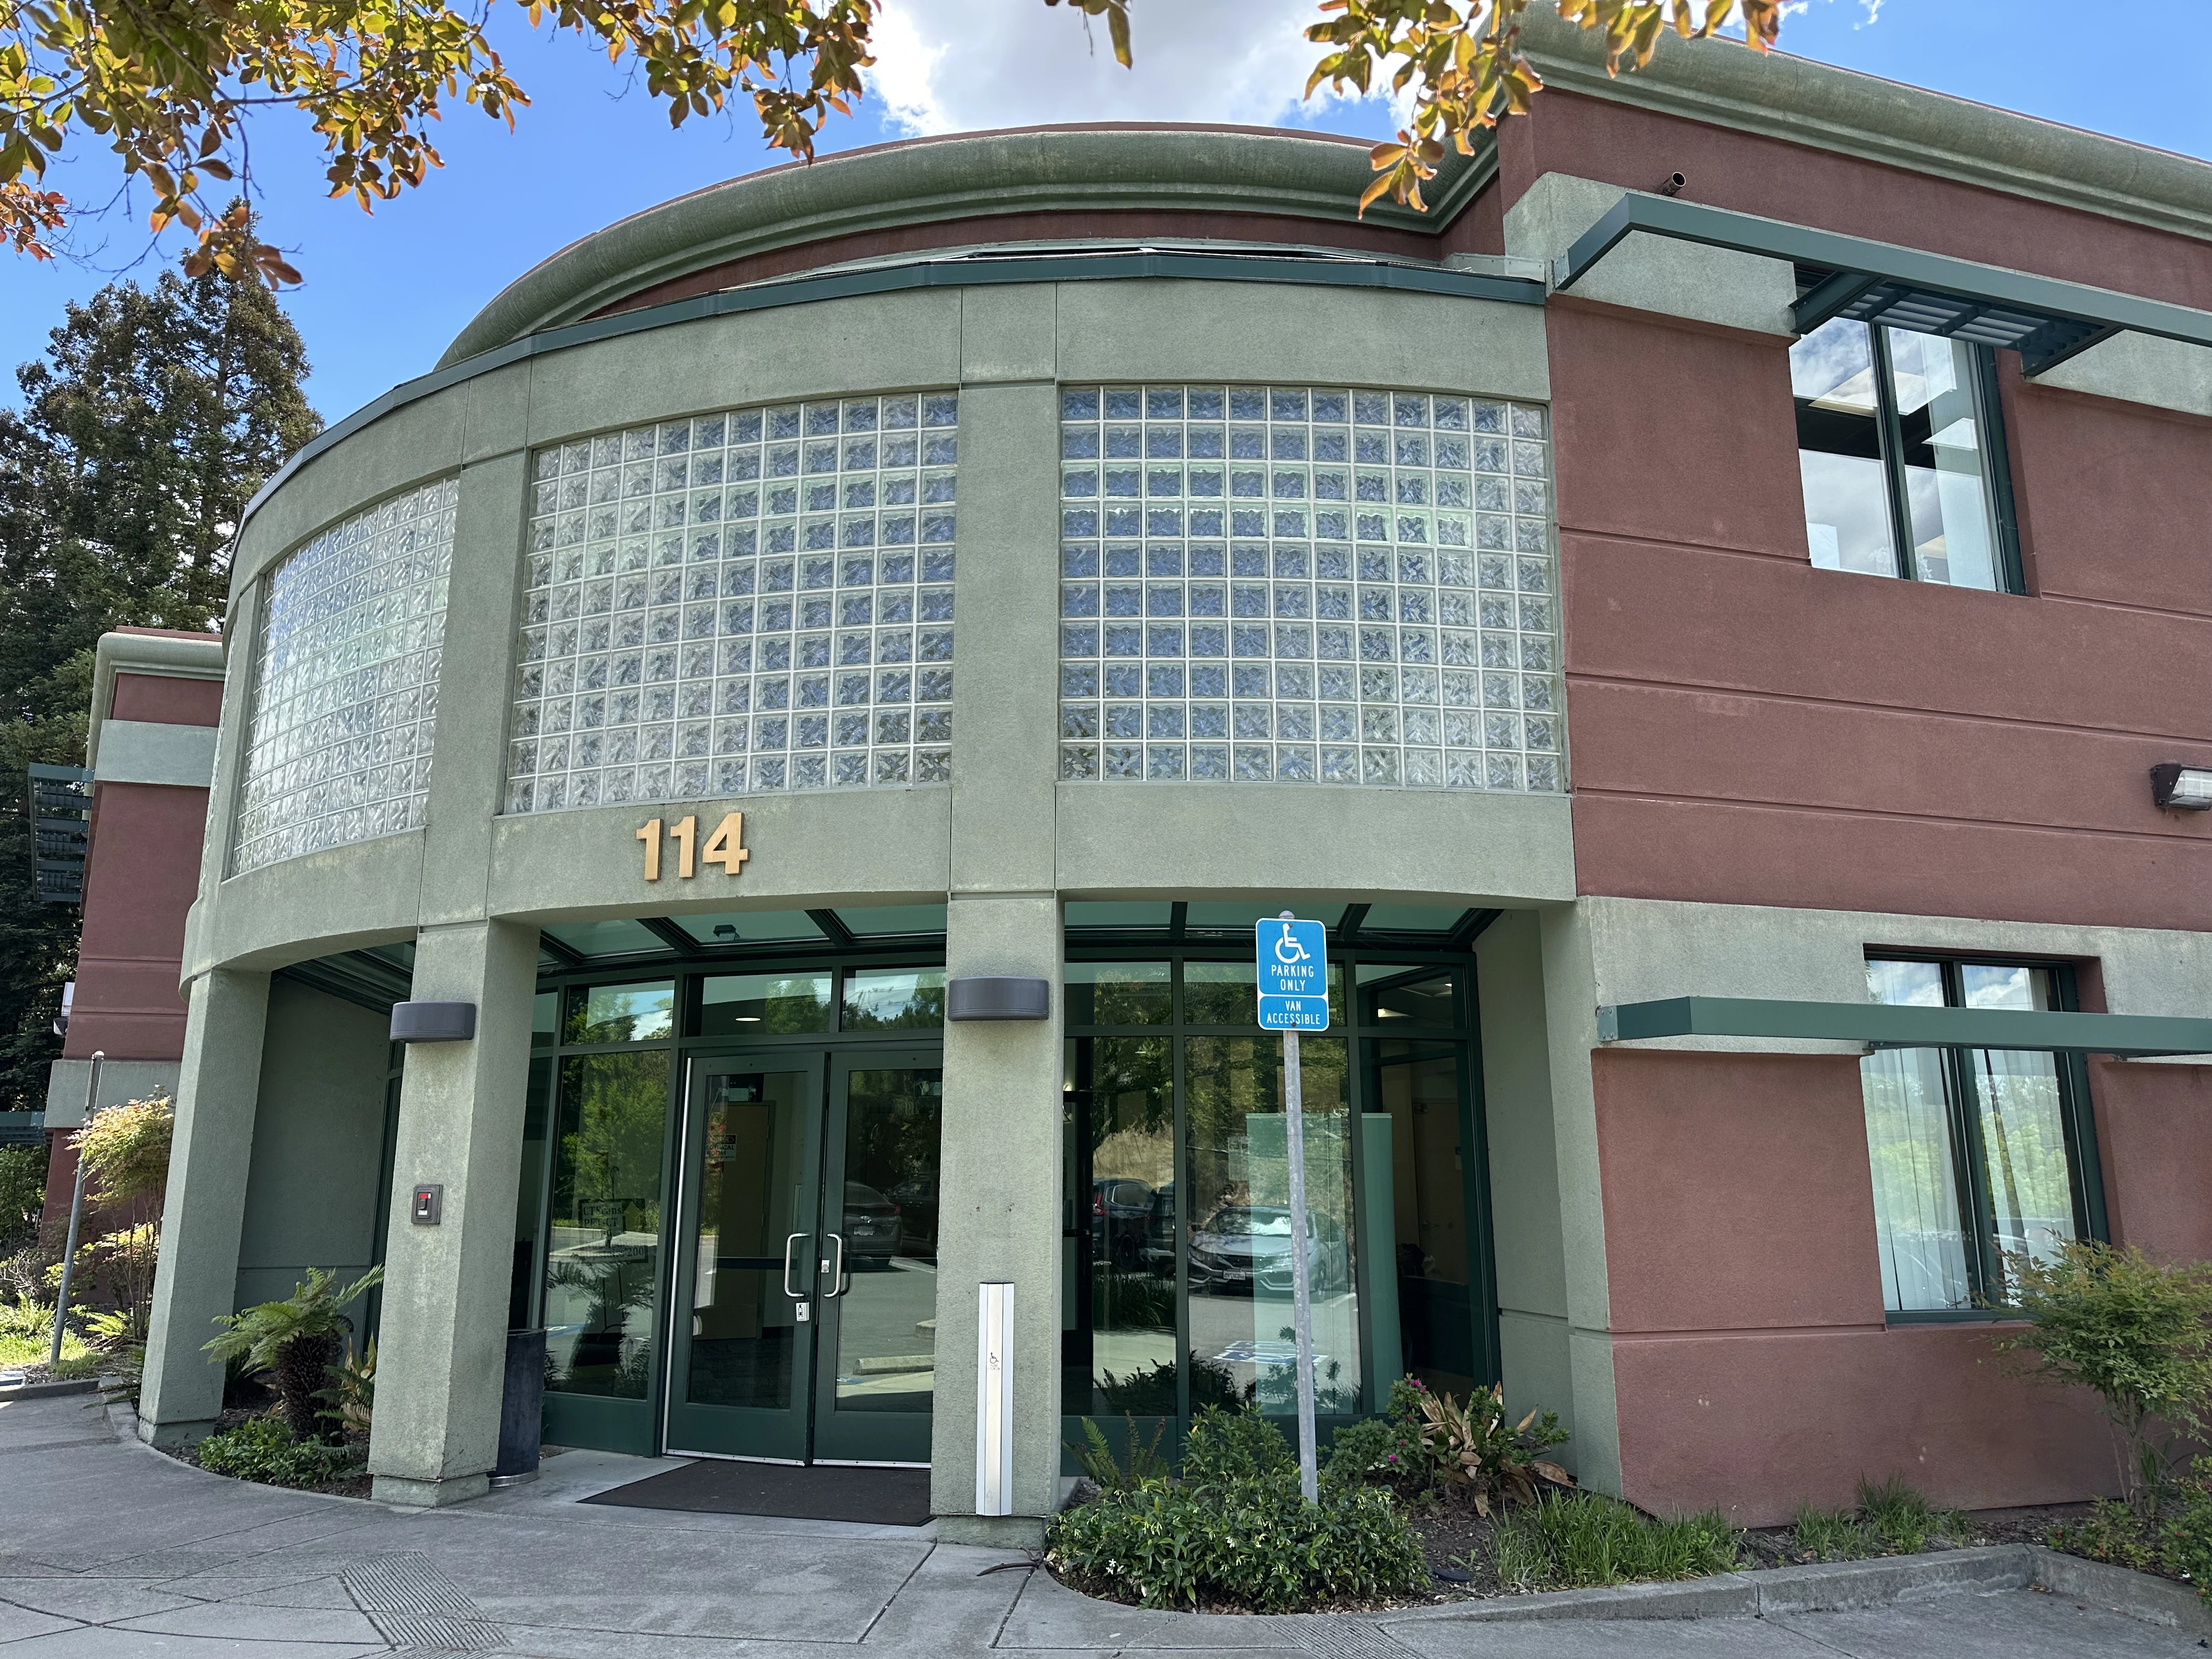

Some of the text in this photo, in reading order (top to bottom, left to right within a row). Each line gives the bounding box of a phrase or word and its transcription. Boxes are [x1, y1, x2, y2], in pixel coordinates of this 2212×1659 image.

[636, 812, 749, 881] 114
[1271, 964, 1314, 978] PARKING
[1280, 979, 1306, 991] ONLY
[1285, 1000, 1301, 1012] VAN
[1266, 1013, 1321, 1025] ACCESSIBLE
